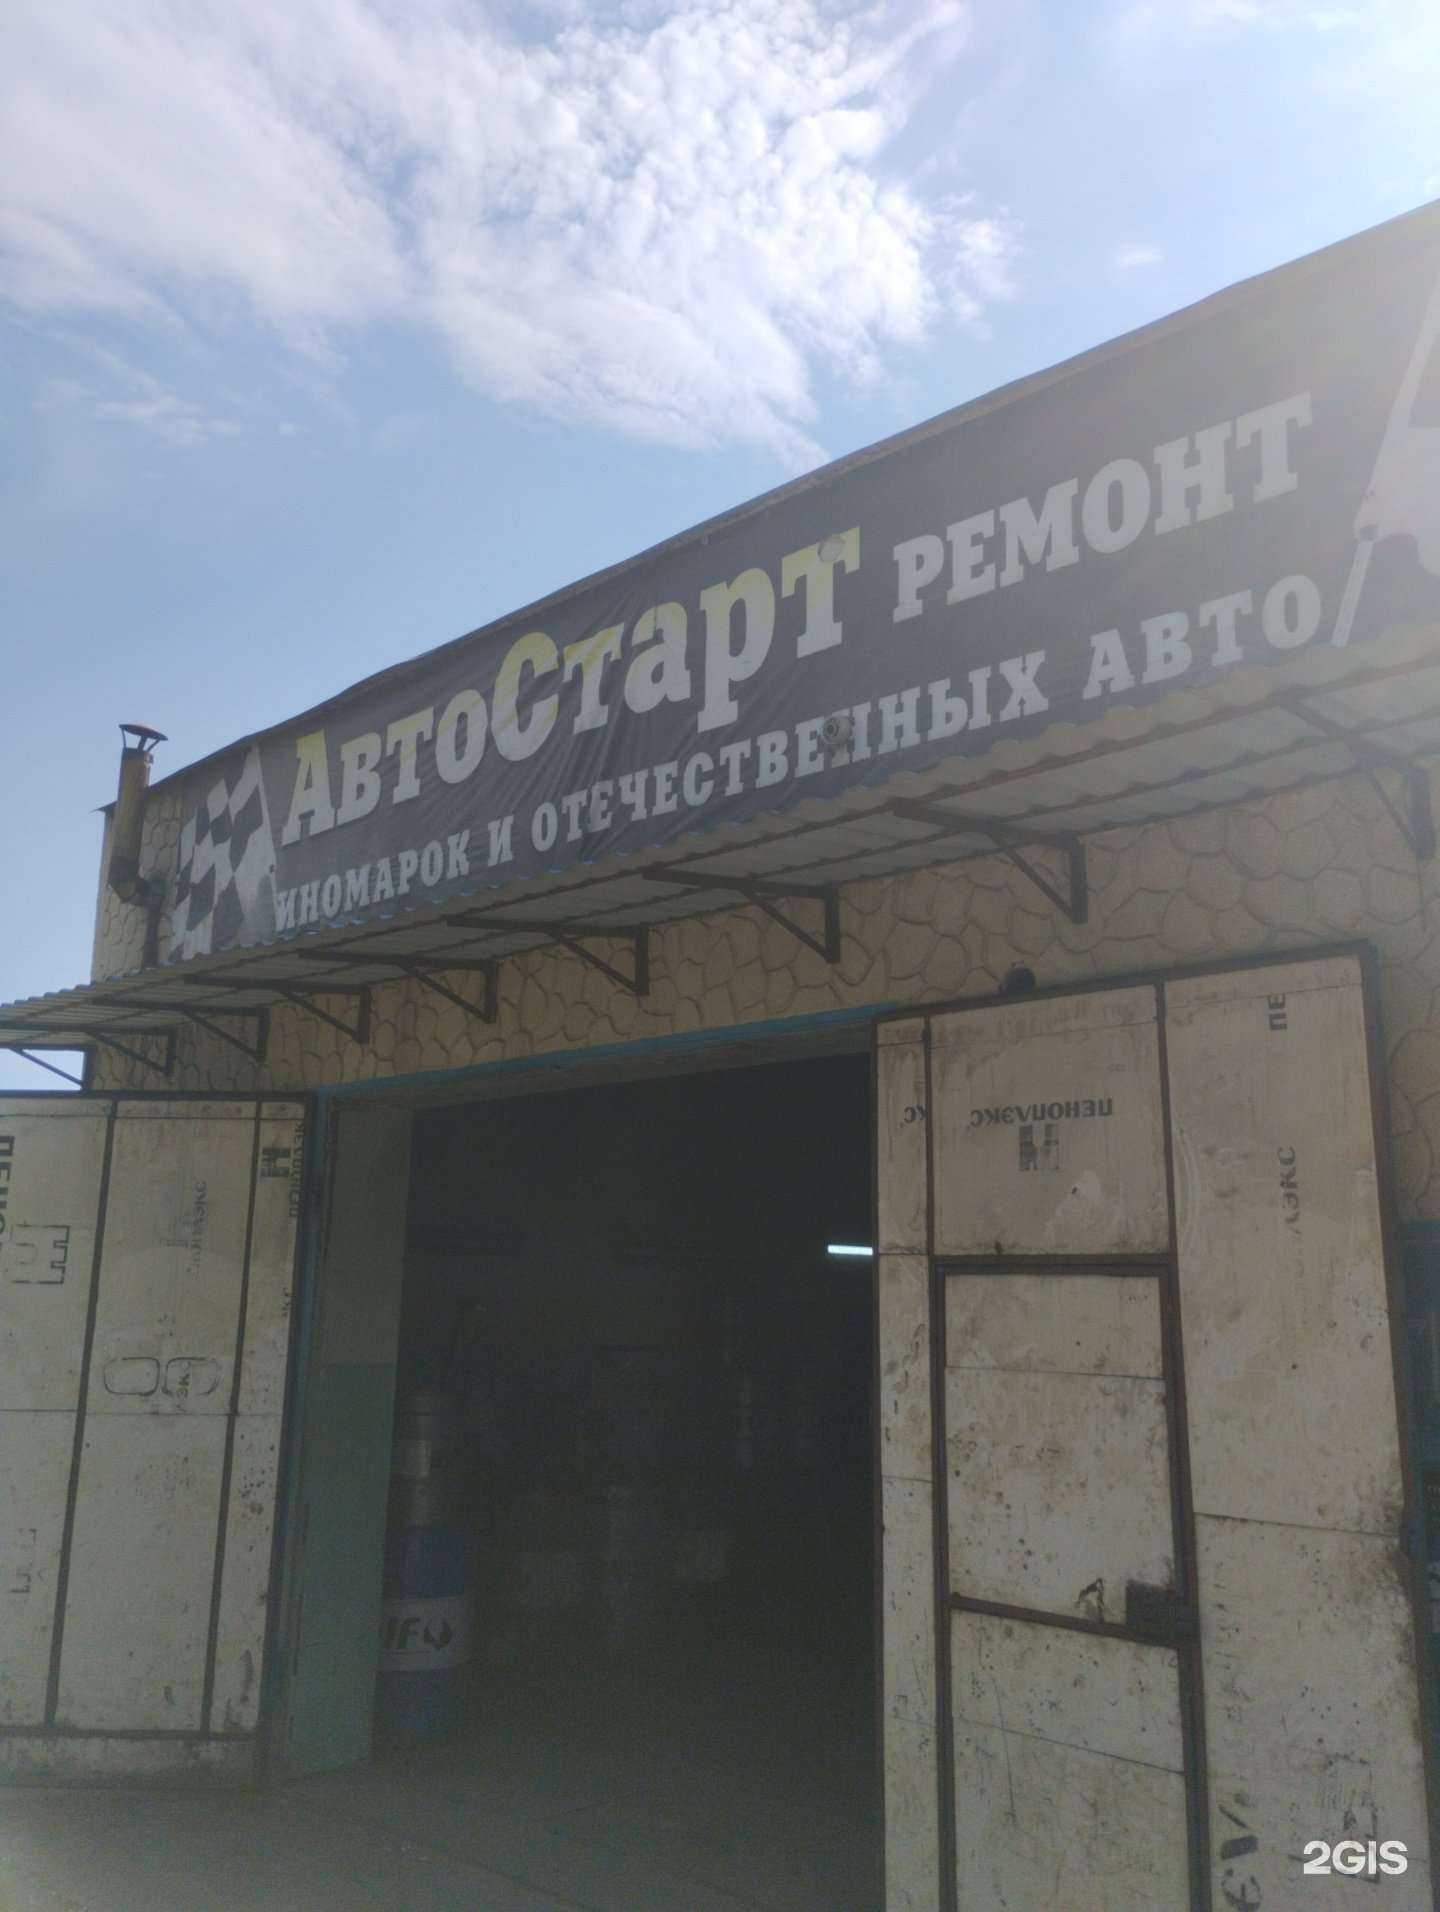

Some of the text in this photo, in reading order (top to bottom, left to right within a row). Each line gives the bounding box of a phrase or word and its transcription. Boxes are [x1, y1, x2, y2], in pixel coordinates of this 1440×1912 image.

[273, 831, 473, 933] ИНОМАРОК
[488, 814, 514, 868] И
[1082, 574, 1323, 701] АВТО
[281, 393, 1313, 846] АвтоСтарт РЕМОНТ
